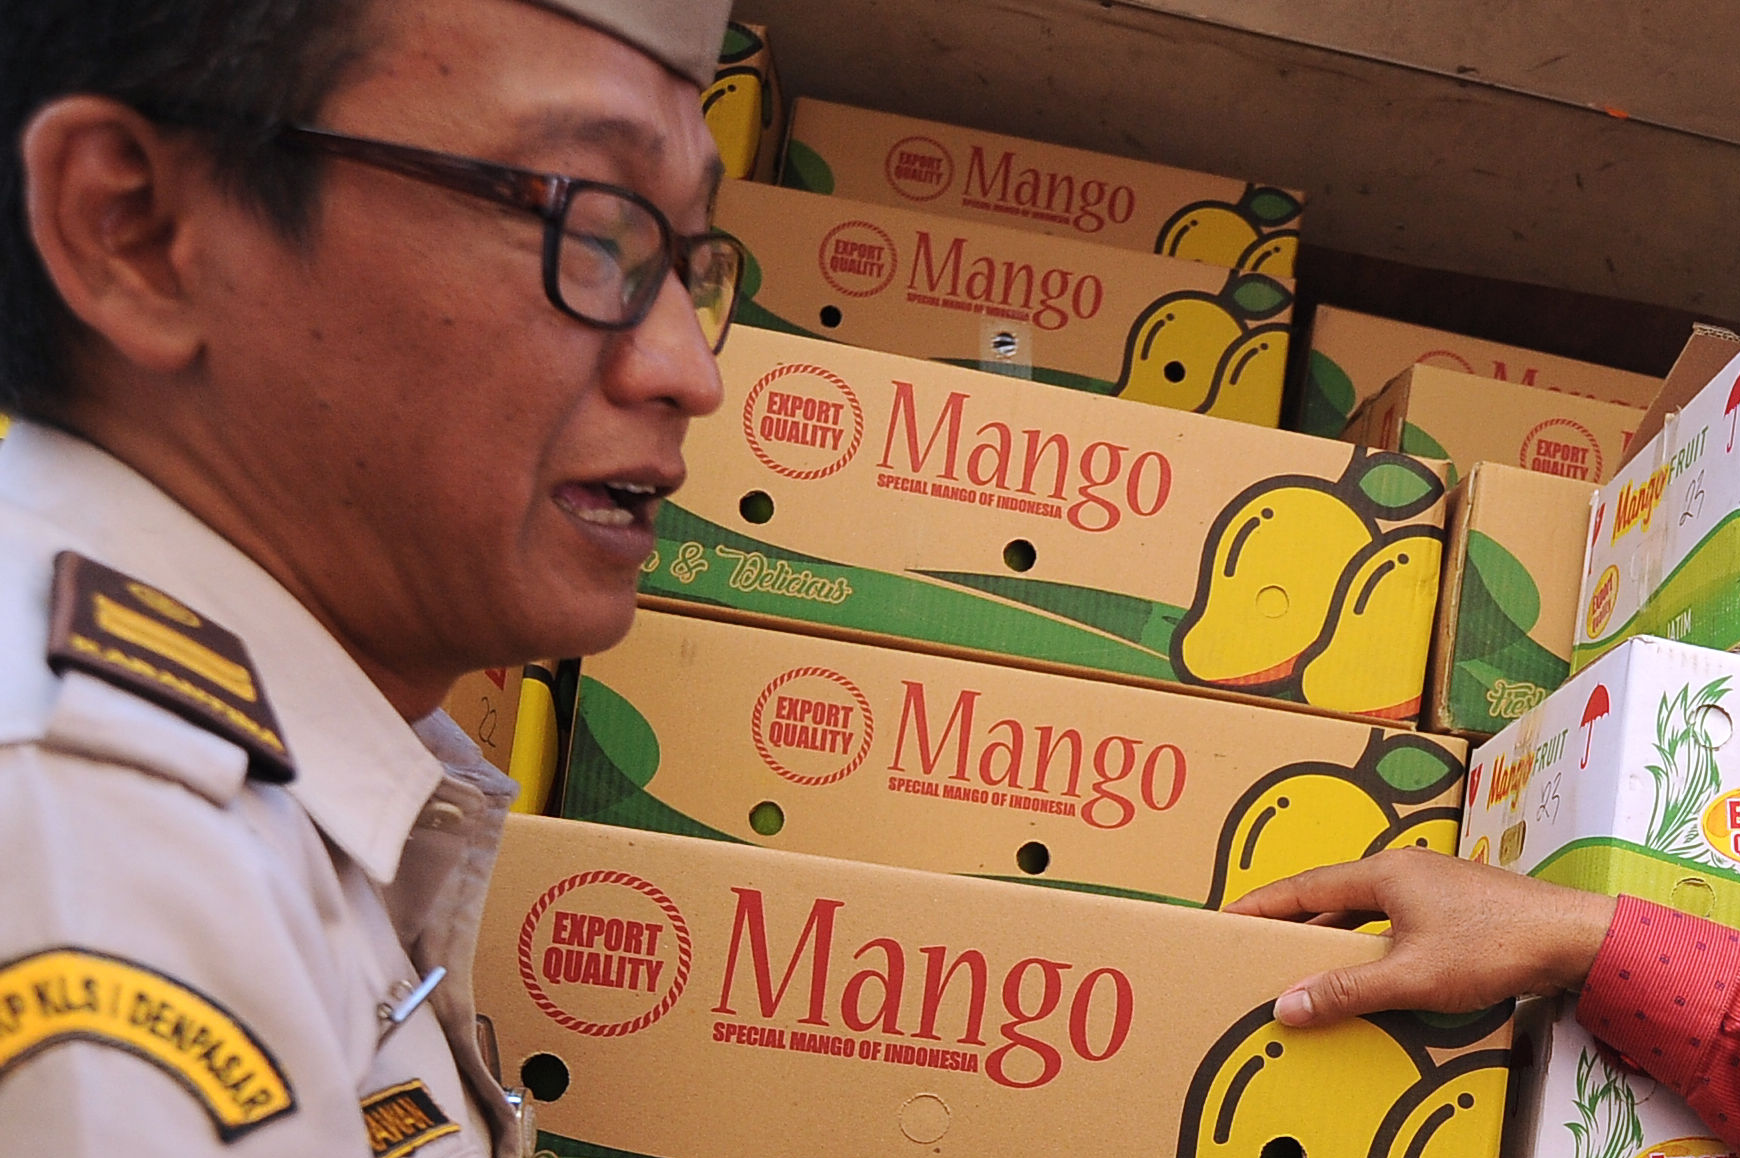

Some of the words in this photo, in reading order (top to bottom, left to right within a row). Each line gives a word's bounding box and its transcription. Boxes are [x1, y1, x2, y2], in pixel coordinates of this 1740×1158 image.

[962, 145, 1136, 233] Mango
[830, 255, 885, 278] QUALITY
[834, 238, 885, 261] EXPORT
[907, 231, 1103, 331] Mango
[759, 413, 845, 452] QUALITY
[767, 391, 845, 430] EXPORT
[876, 380, 1173, 532] Mango
[1532, 457, 1589, 481] QUALITY
[1536, 438, 1589, 465] EXPORT
[877, 473, 929, 495] SPECIAL
[931, 483, 977, 504] MANGO
[978, 491, 995, 507] OF
[996, 495, 1062, 520] INDONESIA
[1611, 465, 1669, 547] Mango
[1667, 425, 1709, 485] FRUIT
[669, 541, 708, 584] &
[715, 545, 853, 604] Delicious
[768, 718, 854, 756] QUALITY
[775, 695, 855, 732] EXPORT
[887, 679, 1188, 830] Mango
[1486, 751, 1534, 812] Mango
[1532, 728, 1568, 774] FRUIT
[888, 776, 940, 797] SPECIAL
[942, 784, 989, 805] MANGO
[990, 791, 1008, 807] OF
[1008, 794, 1076, 817] INDONESIA
[551, 910, 664, 955] EXPORT
[542, 945, 665, 994] QUALITY
[711, 886, 1134, 1089] Mango
[712, 1020, 787, 1050] SPECIAL
[789, 1030, 856, 1059] MANGO
[857, 1038, 882, 1062] OF
[883, 1041, 980, 1074] INDONESIA
